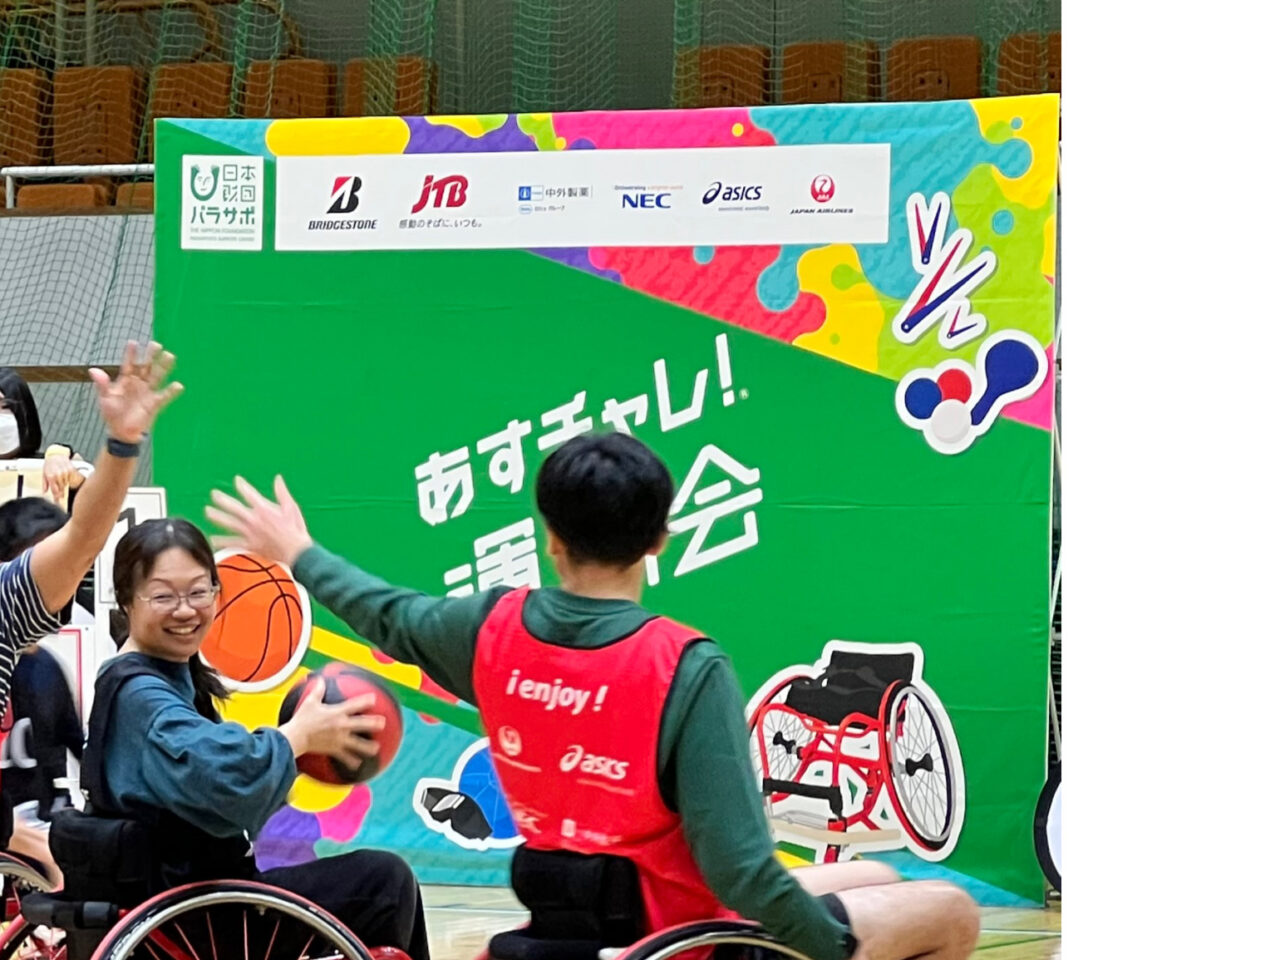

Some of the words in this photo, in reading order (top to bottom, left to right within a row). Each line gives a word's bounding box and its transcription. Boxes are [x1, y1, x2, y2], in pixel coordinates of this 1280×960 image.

[223, 164, 256, 181] 日本
[411, 175, 469, 214] JTB
[545, 186, 589, 198] 中外製薬
[622, 193, 672, 209] NEC
[190, 205, 256, 225] パラサポ
[308, 219, 377, 231] BRIDGESTONE
[443, 443, 764, 598] 運会
